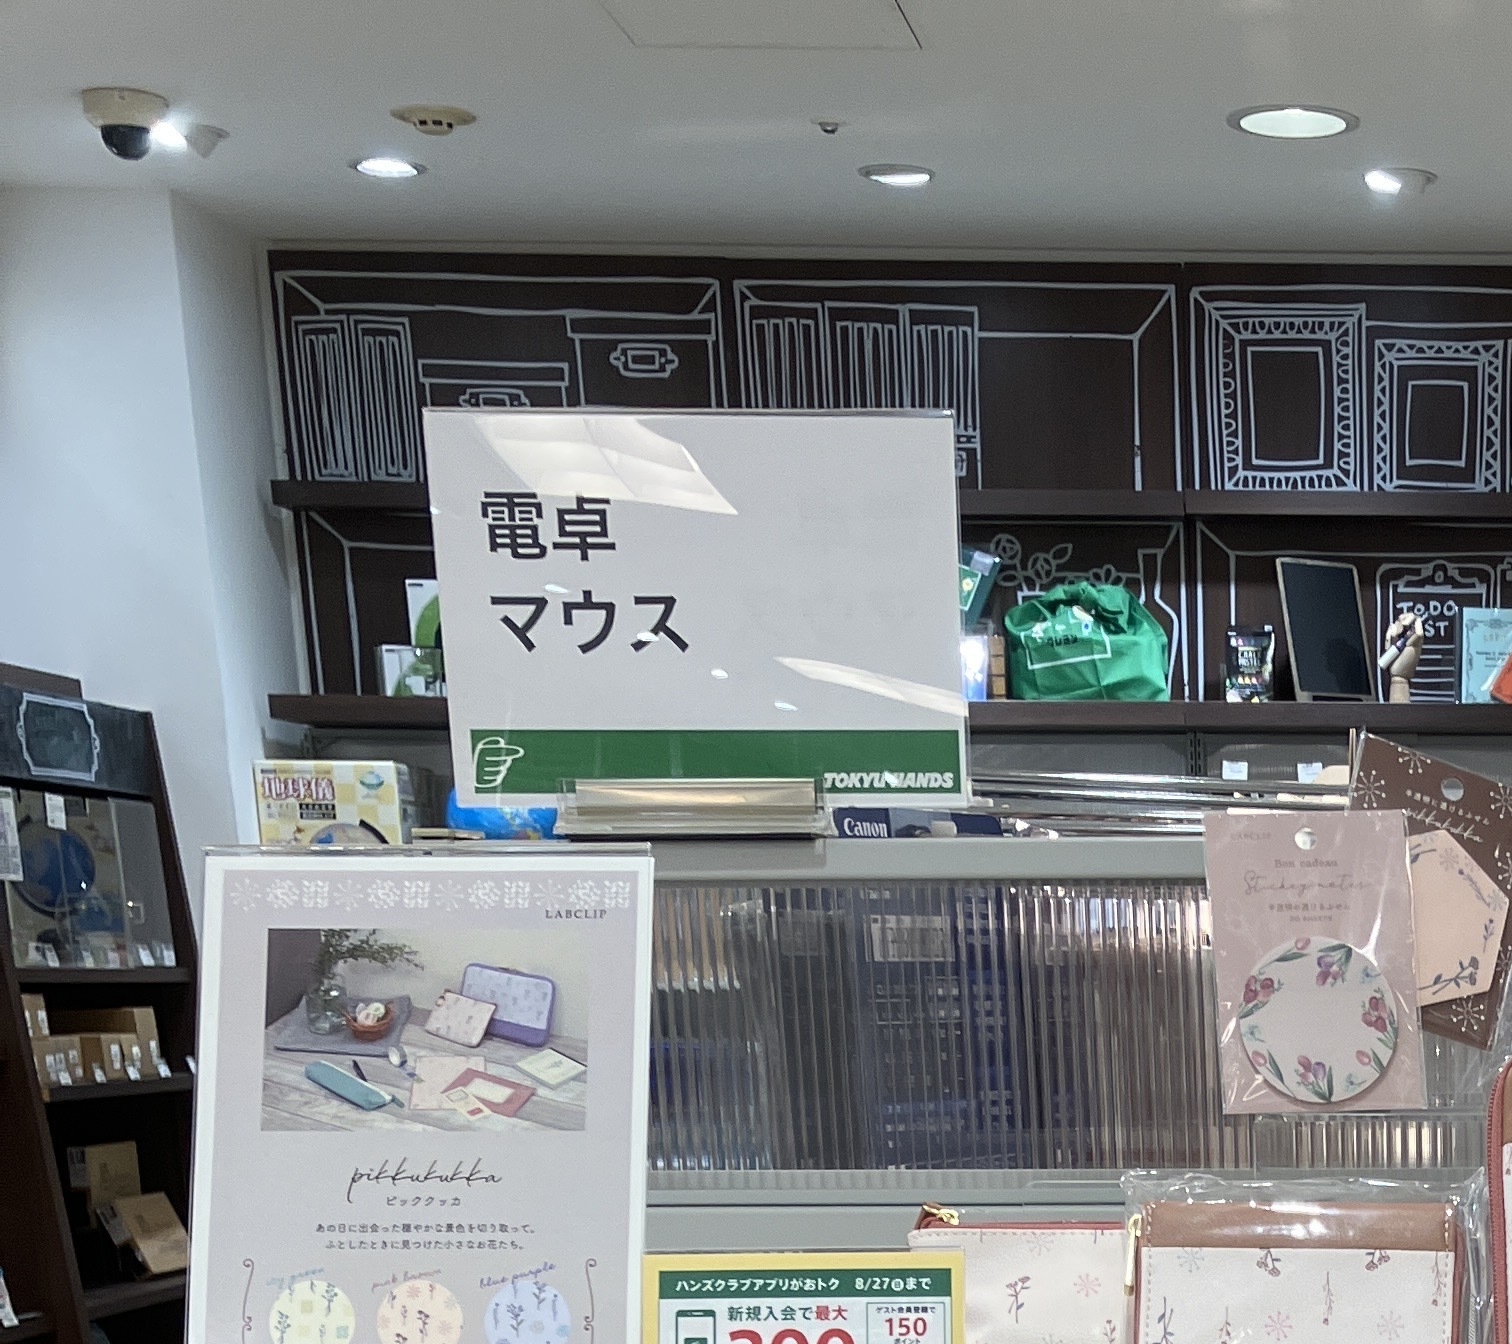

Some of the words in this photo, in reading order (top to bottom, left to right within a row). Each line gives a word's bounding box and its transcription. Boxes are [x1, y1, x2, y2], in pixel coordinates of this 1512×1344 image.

[480, 491, 616, 562] 電卓
[489, 589, 689, 654] マウス
[823, 772, 886, 789] TOKYU
[843, 818, 888, 838] Canon
[1274, 858, 1295, 868] Bon
[1299, 858, 1338, 868] cadeau
[544, 908, 608, 920] LABCLIP
[346, 1157, 503, 1205] pikkukukka
[386, 1195, 462, 1207] ピッククッカ
[675, 1278, 840, 1292] ハンズクラブアプリがおトク
[727, 1305, 848, 1322] 新規入会で最大
[875, 1305, 936, 1314] ゲスト会員登録で
[884, 1316, 928, 1338] 150
